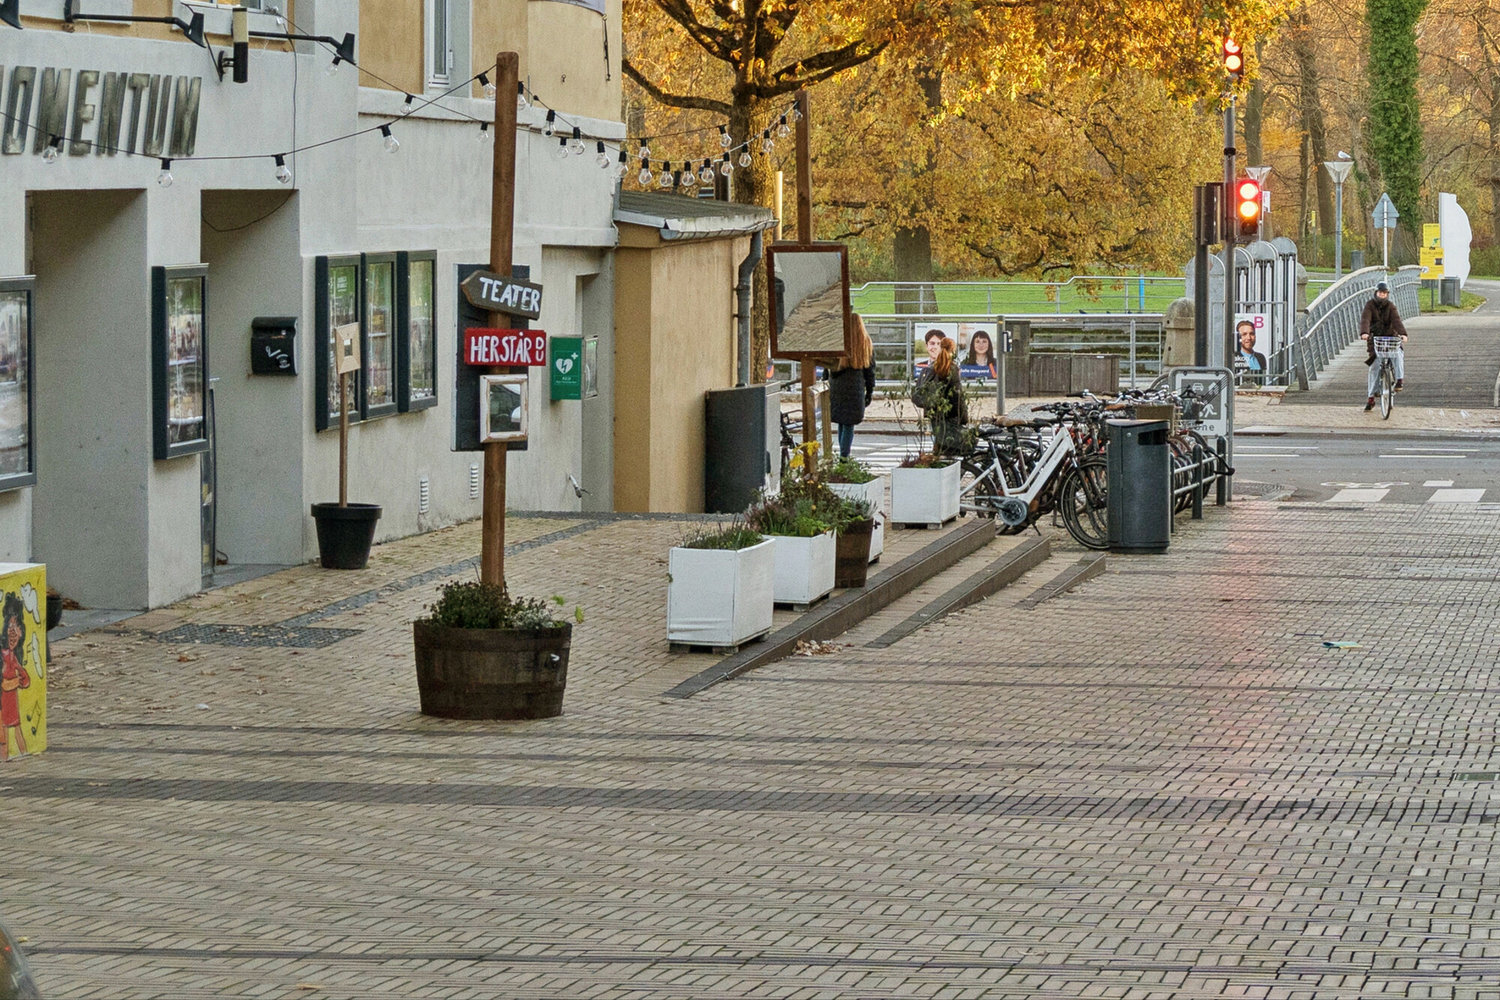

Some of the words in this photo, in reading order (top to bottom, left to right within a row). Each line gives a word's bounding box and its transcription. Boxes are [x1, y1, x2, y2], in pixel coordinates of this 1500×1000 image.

[0, 65, 202, 157] OMENTUM
[480, 276, 540, 312] TEATER
[1254, 316, 1265, 328] B
